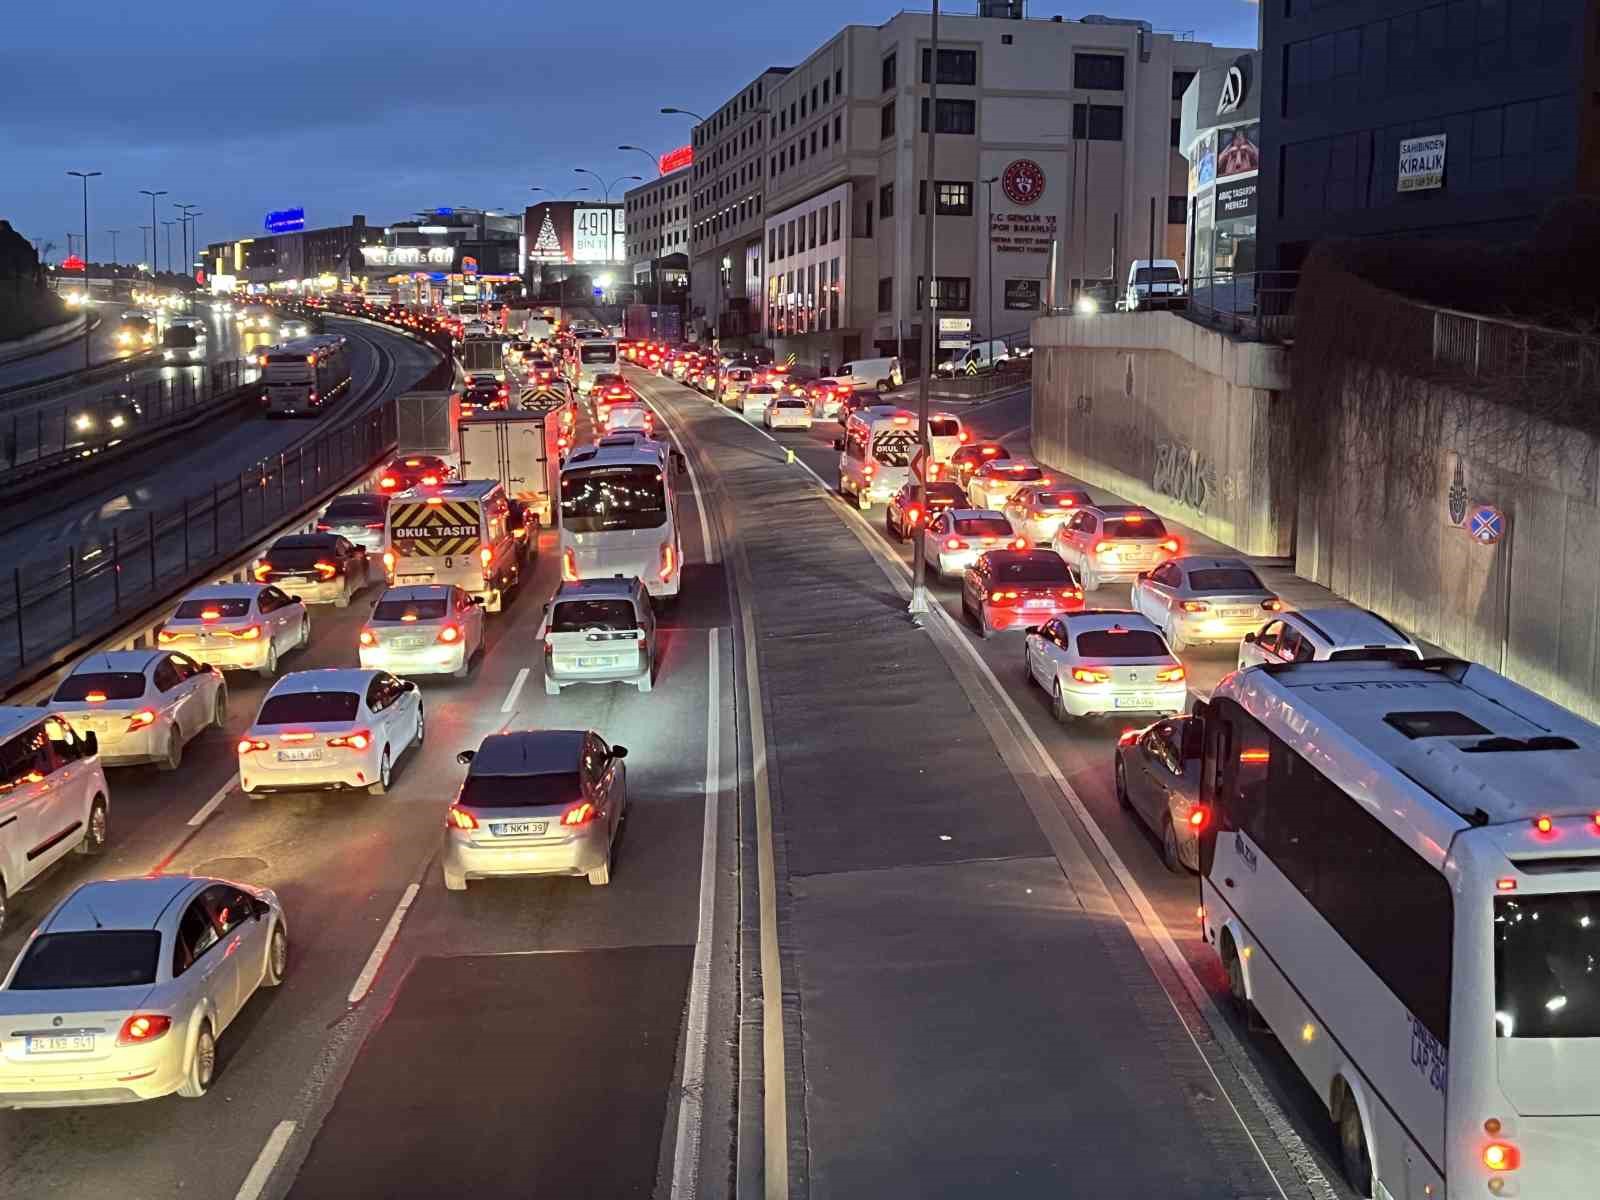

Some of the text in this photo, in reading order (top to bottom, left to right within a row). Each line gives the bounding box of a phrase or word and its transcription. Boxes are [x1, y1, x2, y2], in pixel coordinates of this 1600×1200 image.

[578, 212, 608, 236] 490
[876, 445, 899, 453] OKUL
[396, 527, 431, 538] OKUL
[510, 823, 529, 833] NKM
[532, 823, 543, 833] 39
